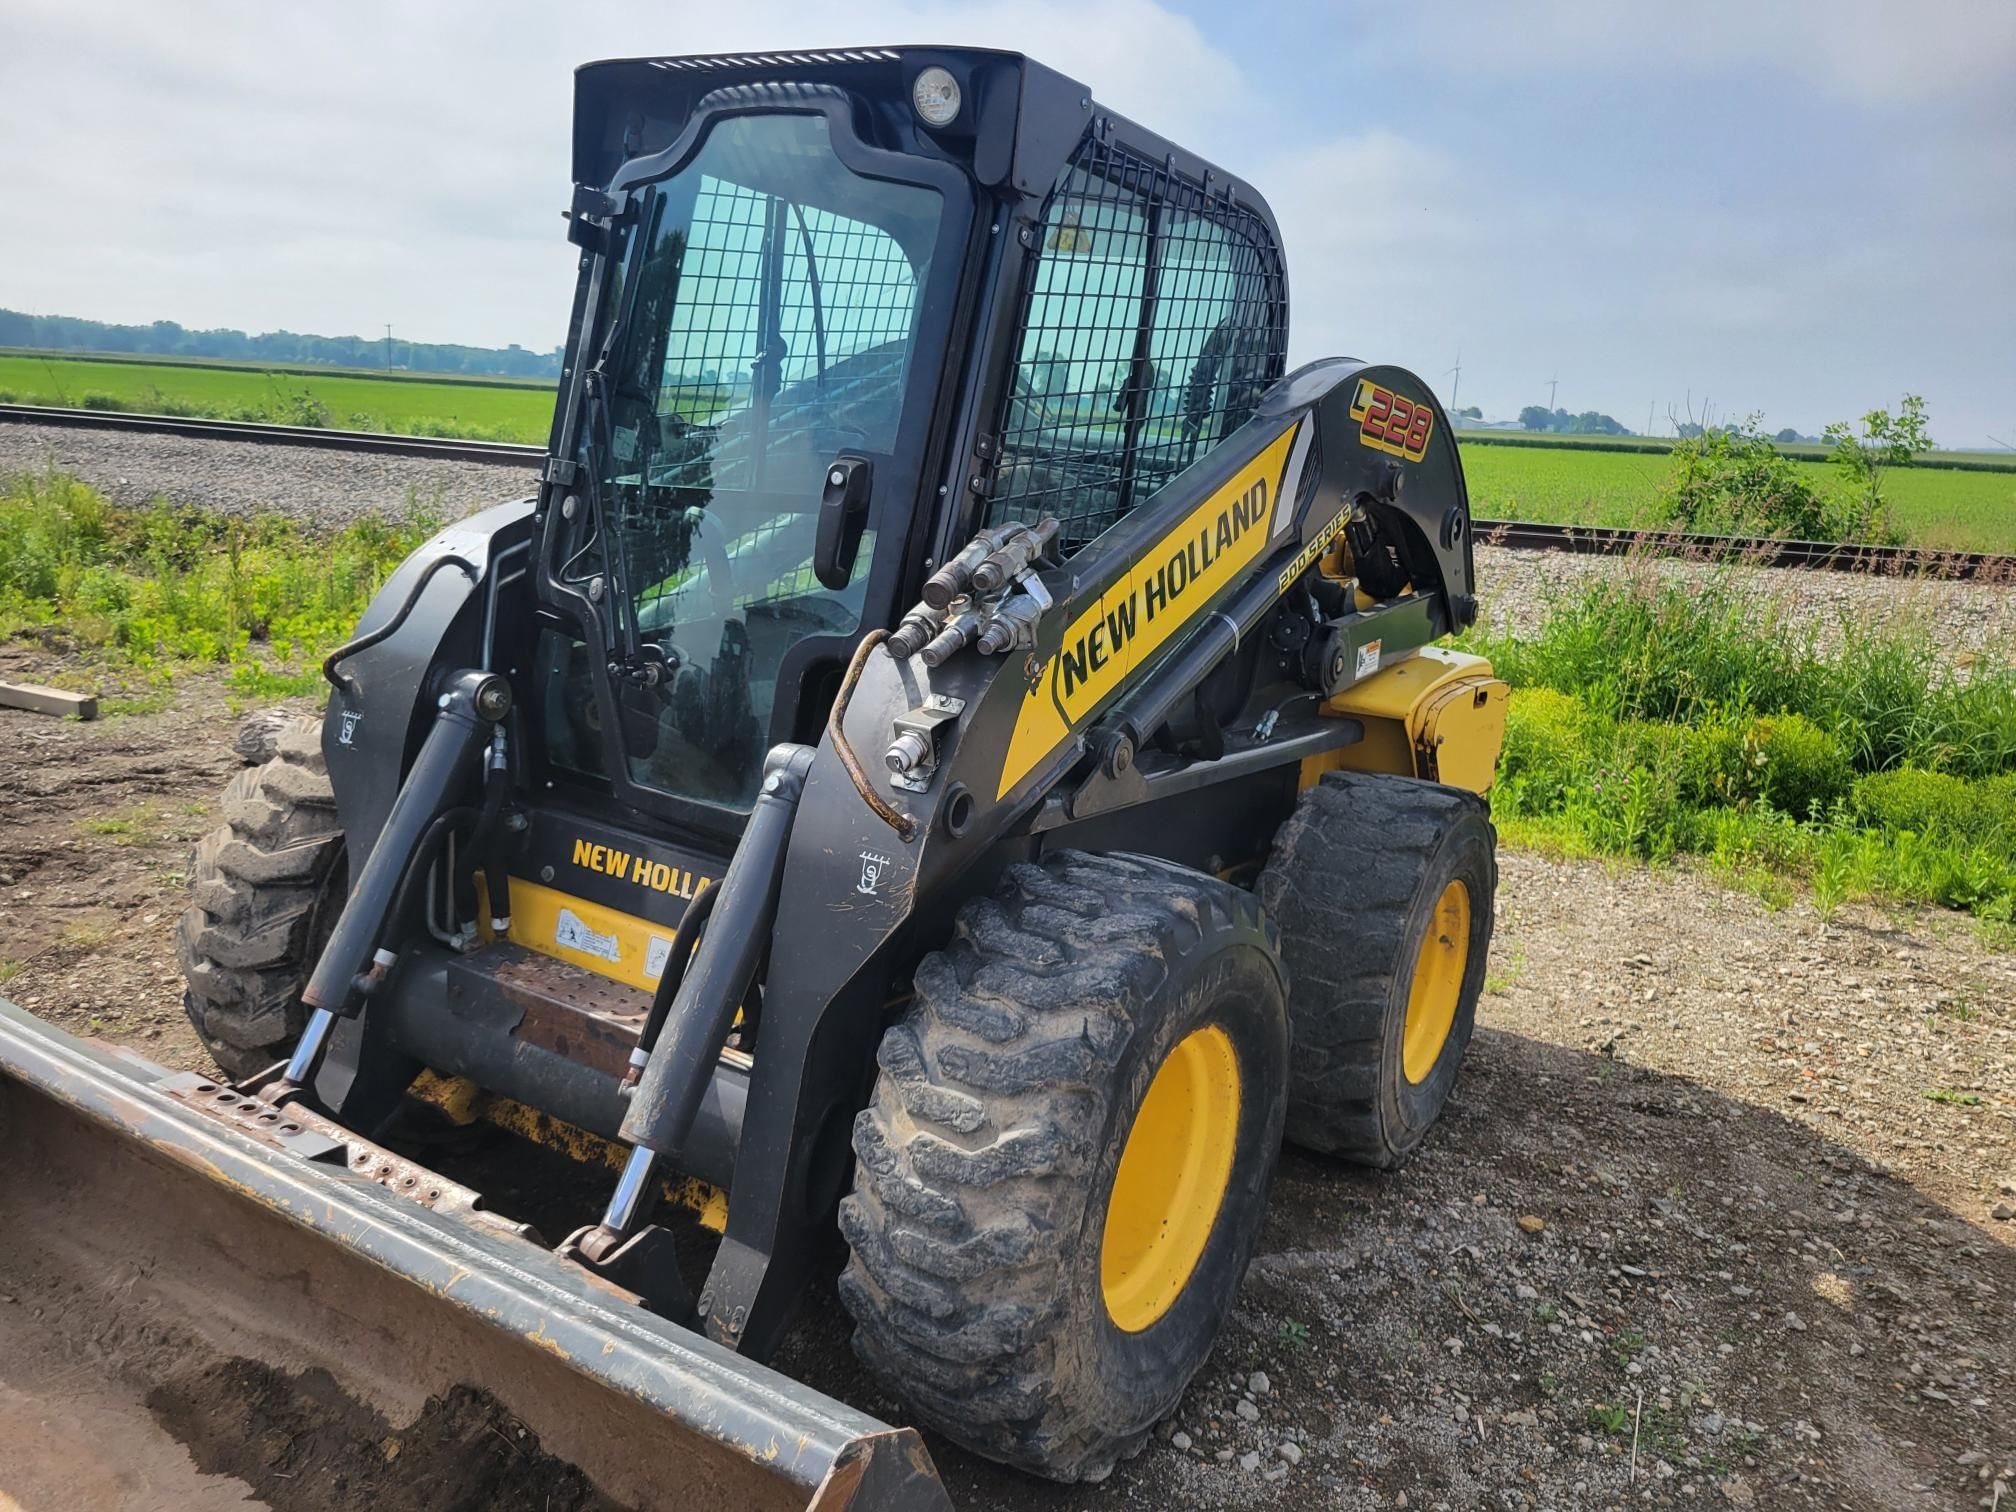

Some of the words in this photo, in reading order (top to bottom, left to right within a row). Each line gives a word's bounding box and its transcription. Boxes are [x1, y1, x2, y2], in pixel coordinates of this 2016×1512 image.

[1351, 380, 1433, 460] L228
[1061, 590, 1137, 699] NEW
[1144, 477, 1268, 623] HOLLAND
[1279, 551, 1307, 592] 200
[1308, 505, 1351, 559] SERIES
[572, 838, 631, 879] NEW
[631, 857, 711, 900] HOLLA
